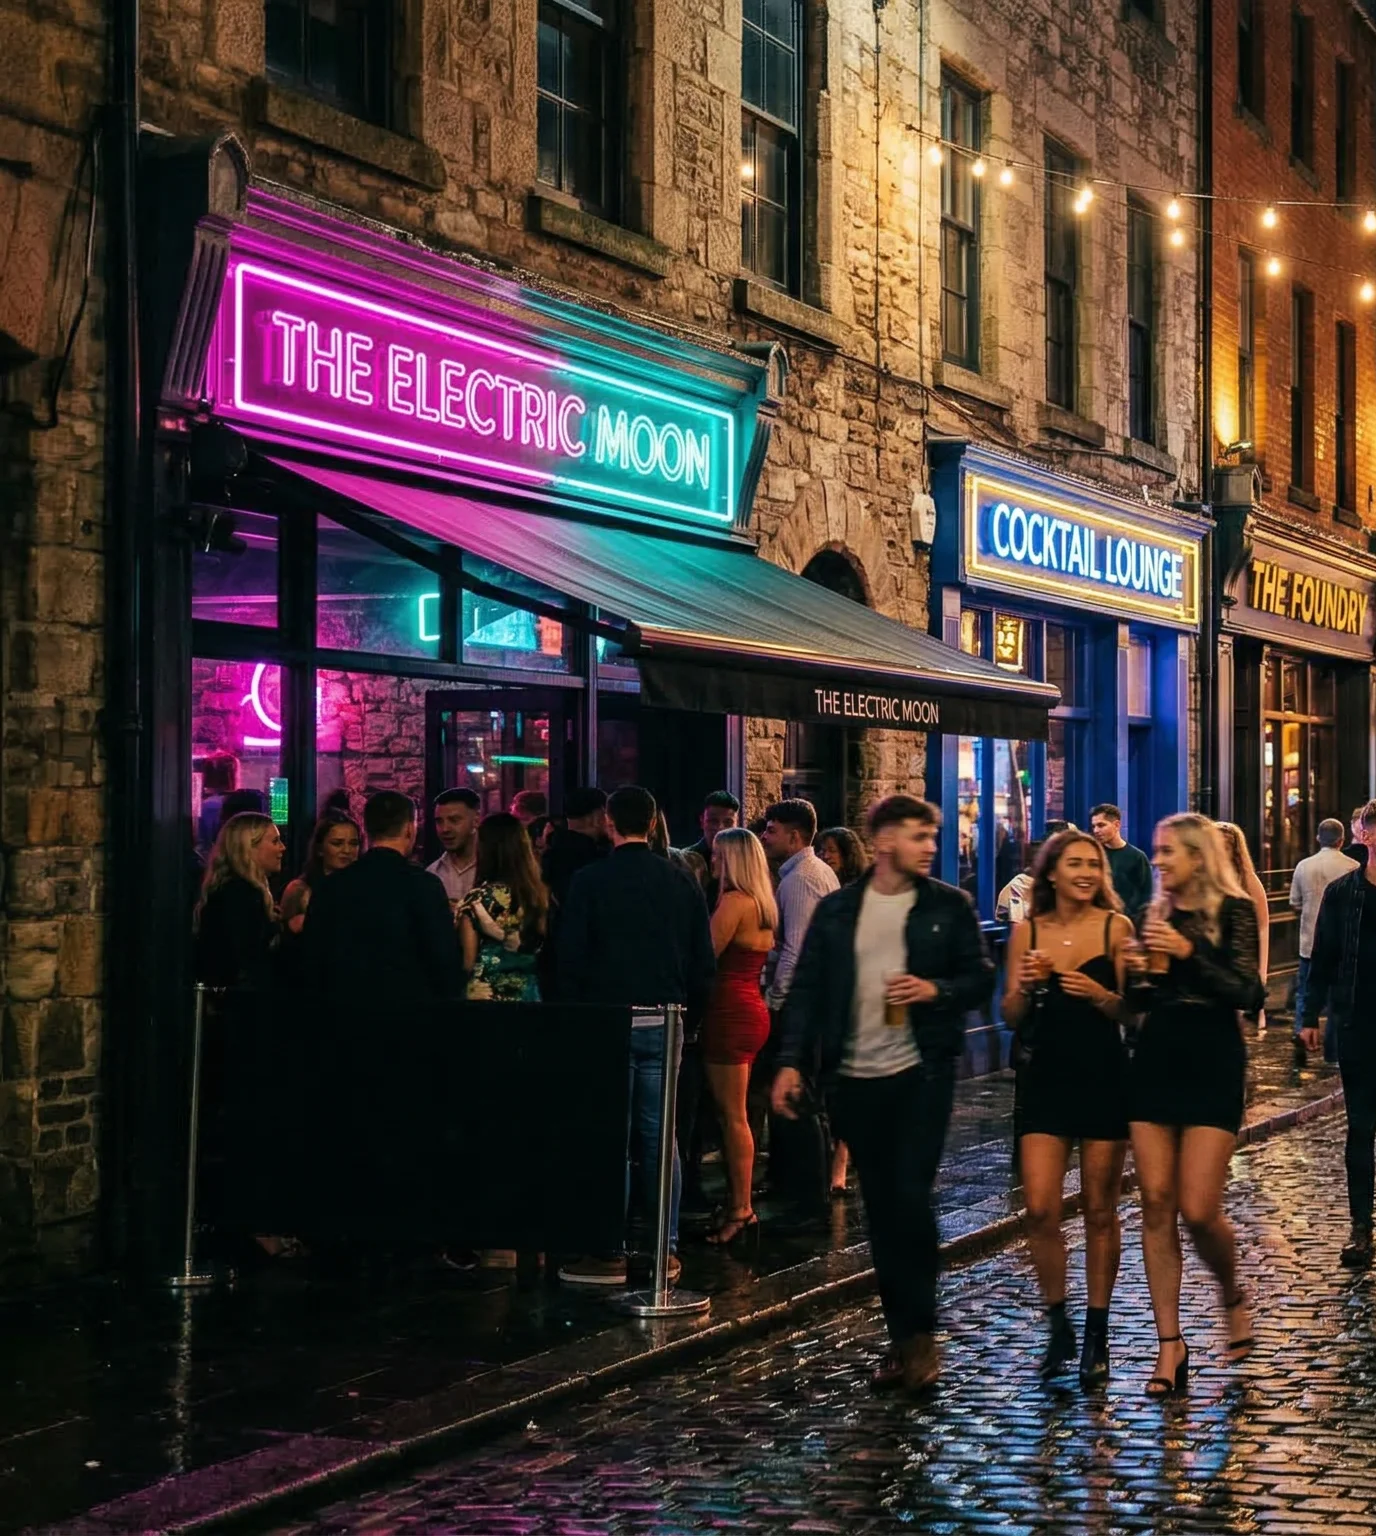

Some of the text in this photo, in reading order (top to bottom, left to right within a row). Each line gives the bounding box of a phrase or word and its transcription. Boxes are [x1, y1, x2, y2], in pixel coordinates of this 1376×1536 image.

[271, 310, 712, 490] THE ELECTRIC MOON
[993, 503, 1184, 599] COCKTAIL LOUNGE
[1252, 560, 1368, 637] THE FOUNDRY
[814, 689, 939, 724] THE ELECTRIC MOON
